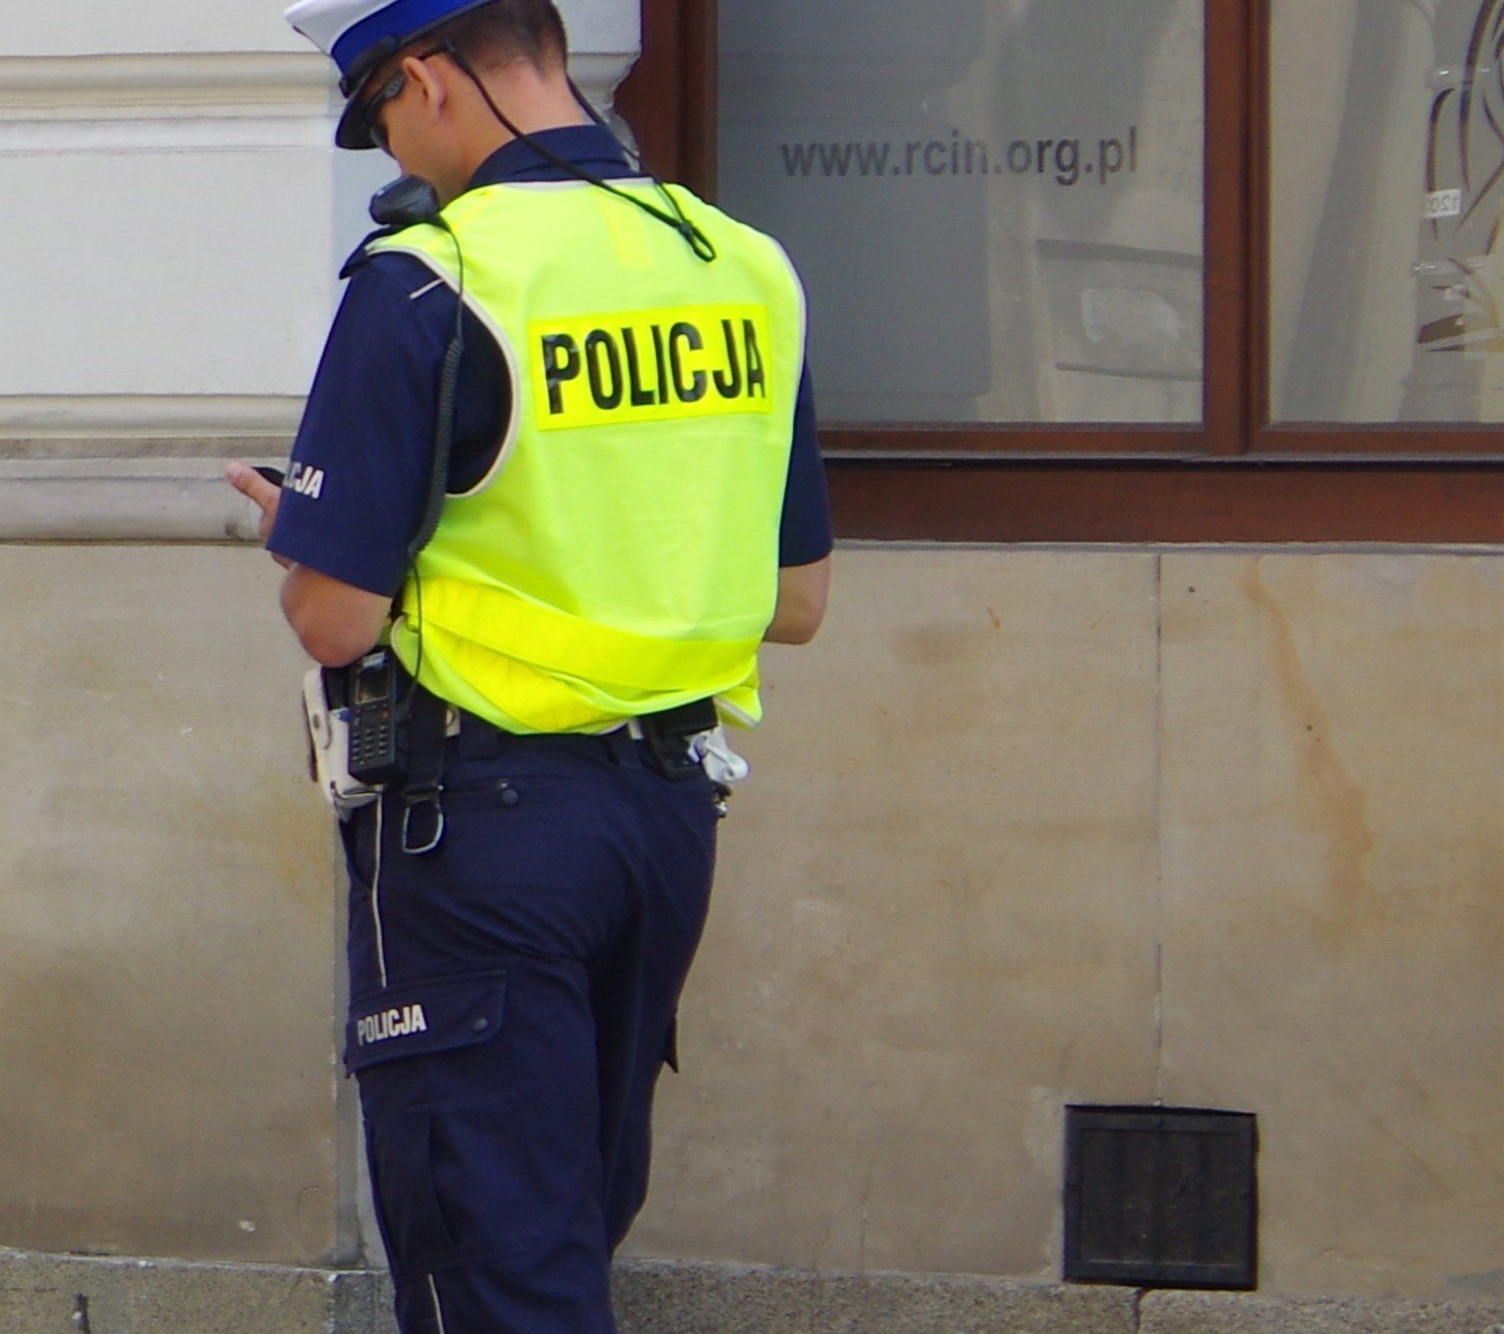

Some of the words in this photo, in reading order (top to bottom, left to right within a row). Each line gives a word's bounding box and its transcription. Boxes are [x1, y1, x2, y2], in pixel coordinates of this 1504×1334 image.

[782, 126, 1137, 186] www.rcin.org.pl
[540, 317, 766, 415] POLICJA
[287, 462, 325, 499] CJA
[357, 1004, 427, 1046] POLICJA
